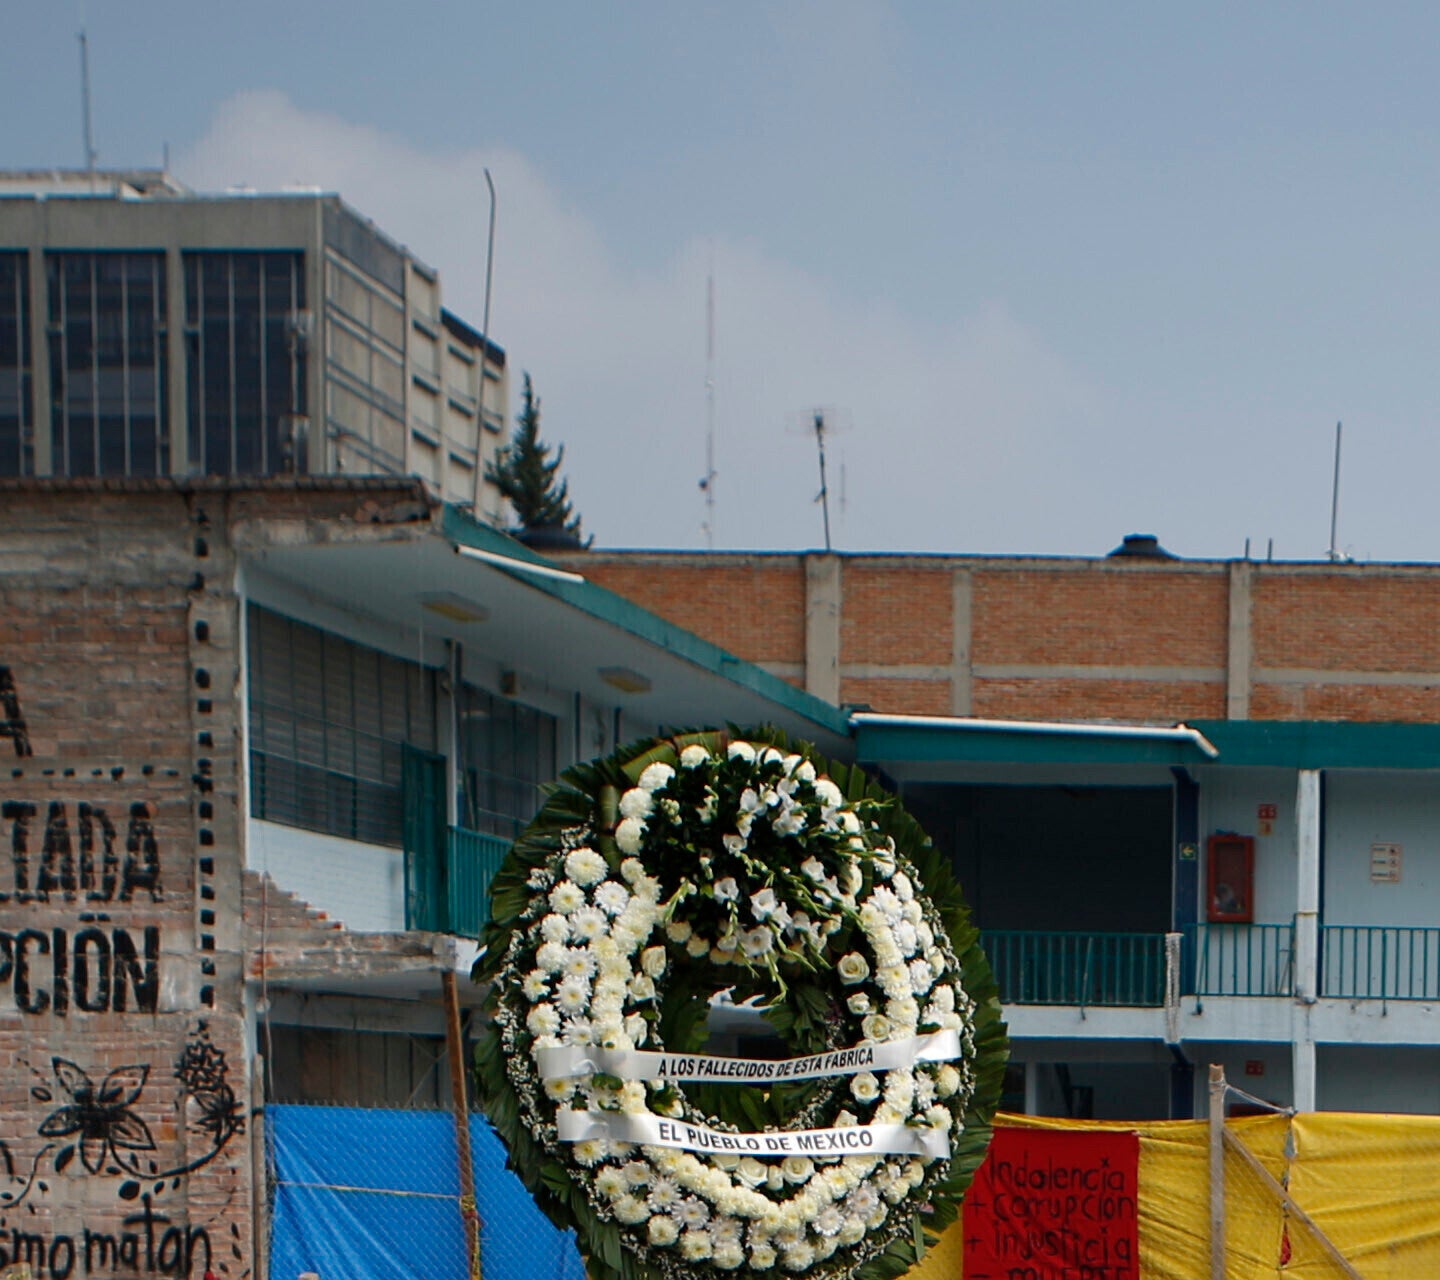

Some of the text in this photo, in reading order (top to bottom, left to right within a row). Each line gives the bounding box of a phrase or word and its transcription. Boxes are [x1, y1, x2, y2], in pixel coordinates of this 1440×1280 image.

[658, 1047, 874, 1078] A LOS FALLECIDOS DE ESTA FABRICA
[659, 1122, 874, 1150] EL PUEBLO DE MEXICO
[989, 1150, 1126, 1192] Indolencia
[83, 1193, 214, 1280] matan
